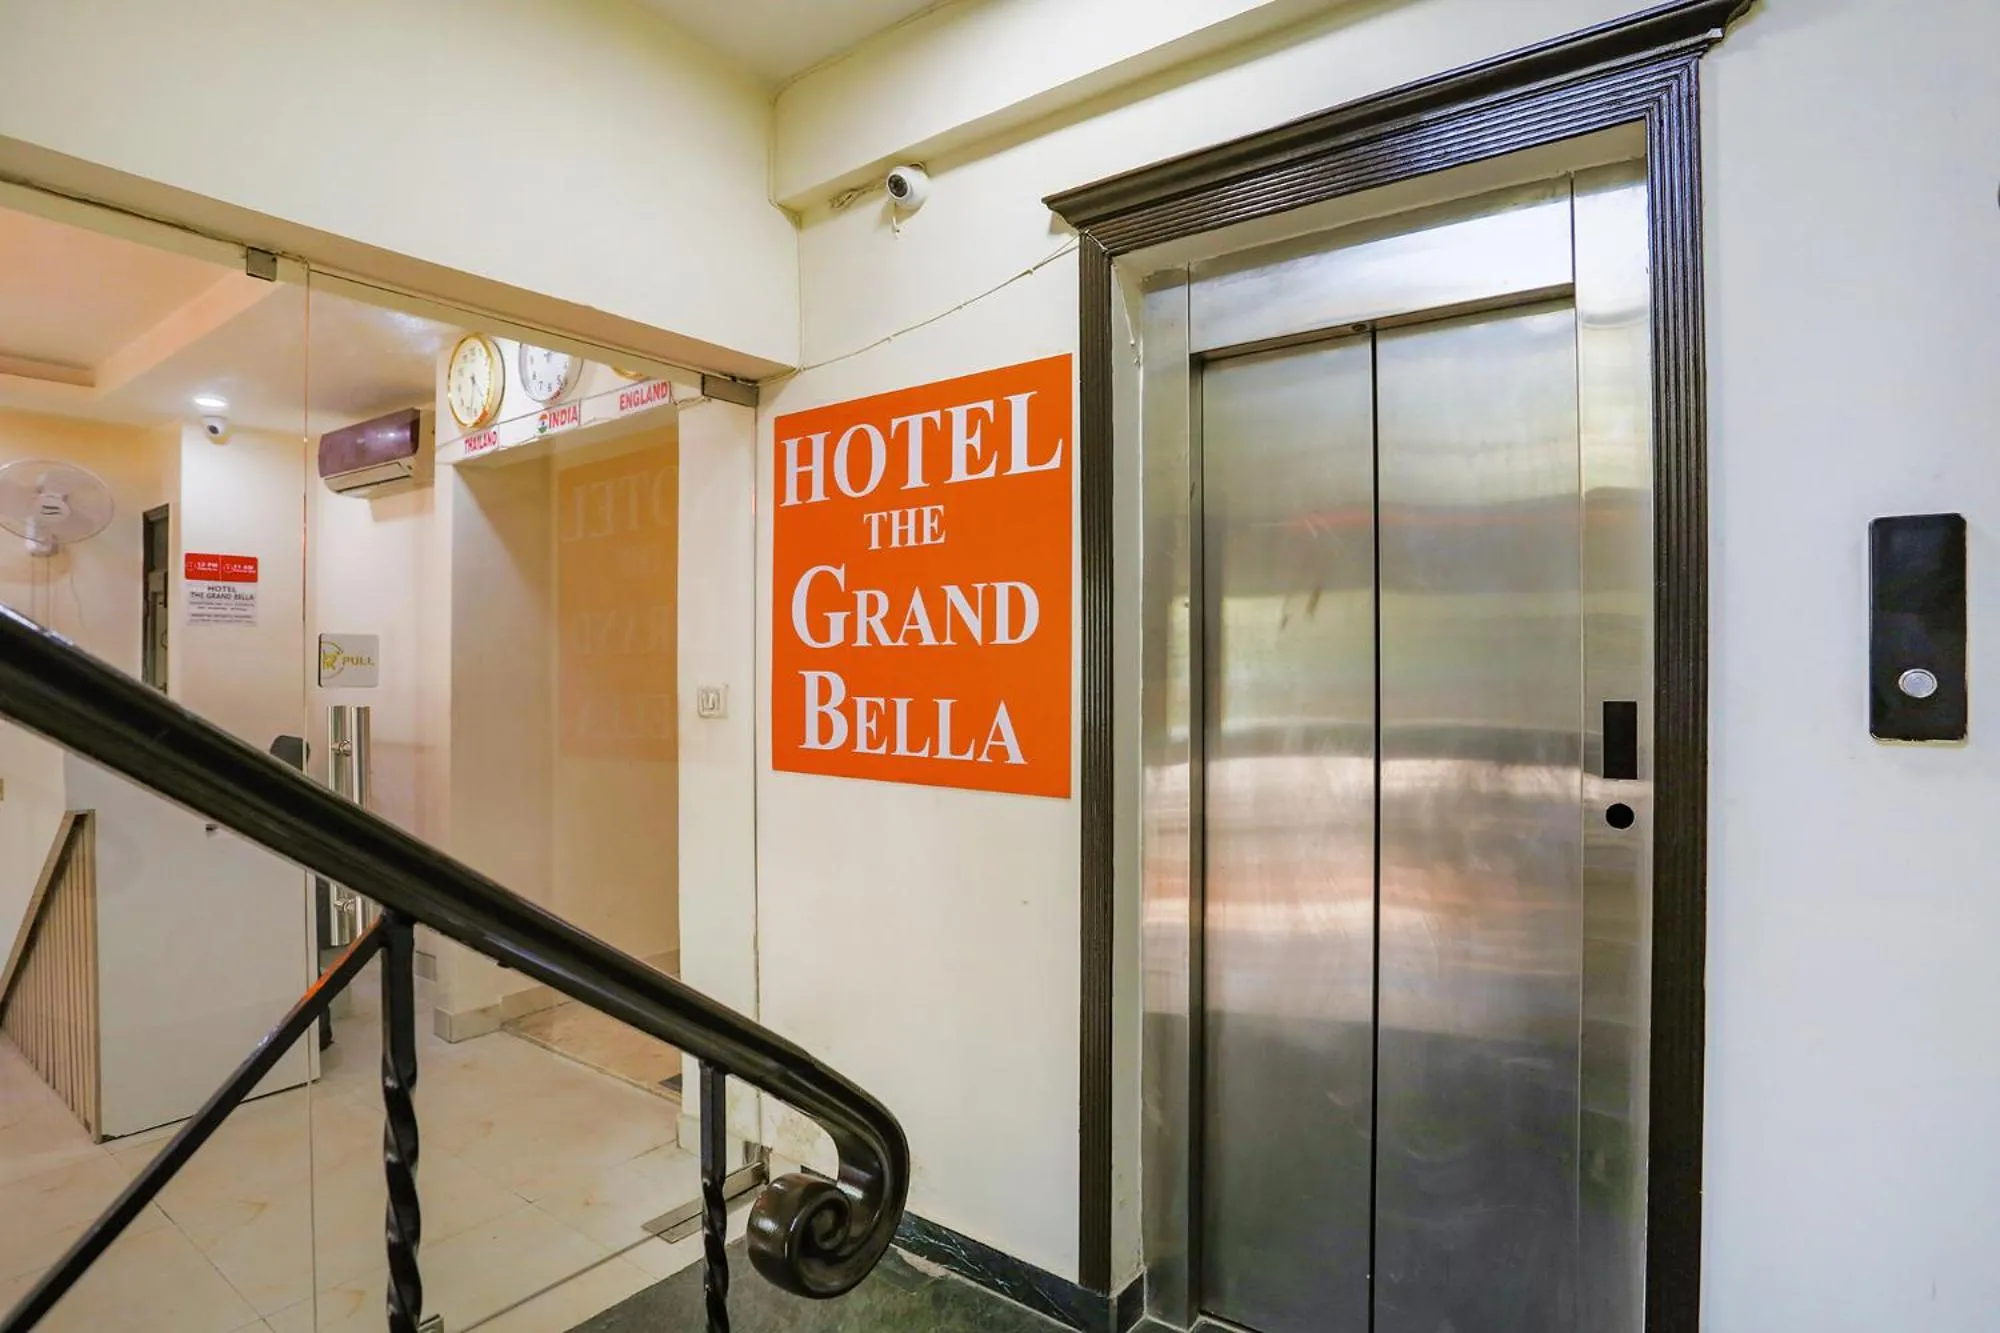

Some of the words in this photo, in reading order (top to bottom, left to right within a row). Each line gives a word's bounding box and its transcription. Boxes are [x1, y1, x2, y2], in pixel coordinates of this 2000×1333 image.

[619, 382, 669, 411] ENGLAND
[549, 407, 578, 429] INDIA
[464, 431, 497, 454] THAILAND
[779, 391, 1063, 508] HOTEL
[863, 504, 946, 550] THE
[190, 591, 204, 599] THE
[206, 592, 232, 600] GRAND
[234, 593, 254, 601] BELLA
[207, 585, 236, 593] HOTEL
[791, 563, 1040, 649] GRAND
[342, 656, 376, 666] PULL
[798, 669, 1028, 765] BELLA
